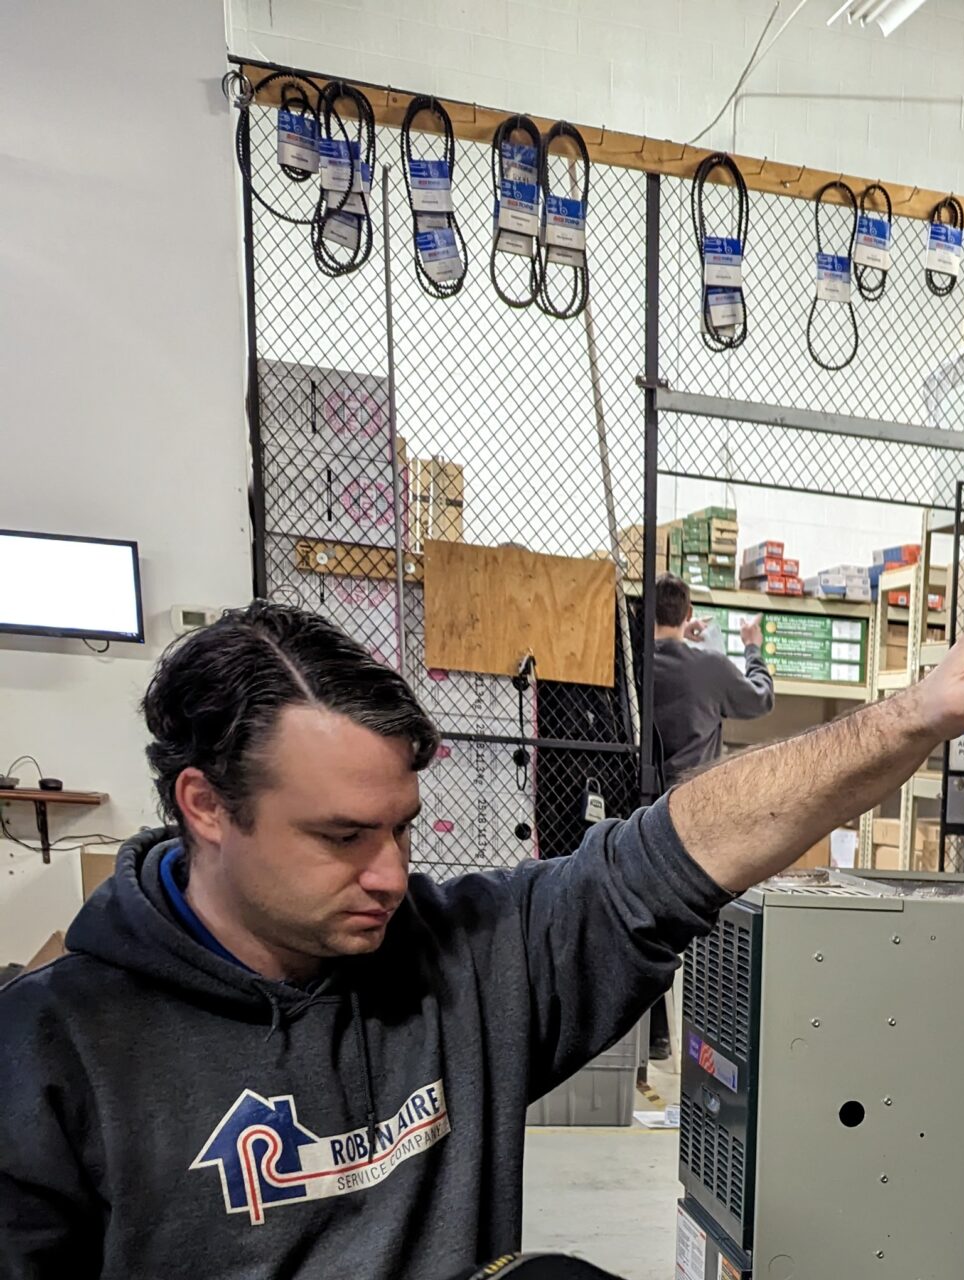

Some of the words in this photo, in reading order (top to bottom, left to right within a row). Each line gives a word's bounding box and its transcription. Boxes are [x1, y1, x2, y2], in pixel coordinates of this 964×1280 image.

[398, 1087, 440, 1135] AIRE
[338, 1163, 387, 1191] SERVICE
[390, 1124, 442, 1165] COMPANY
